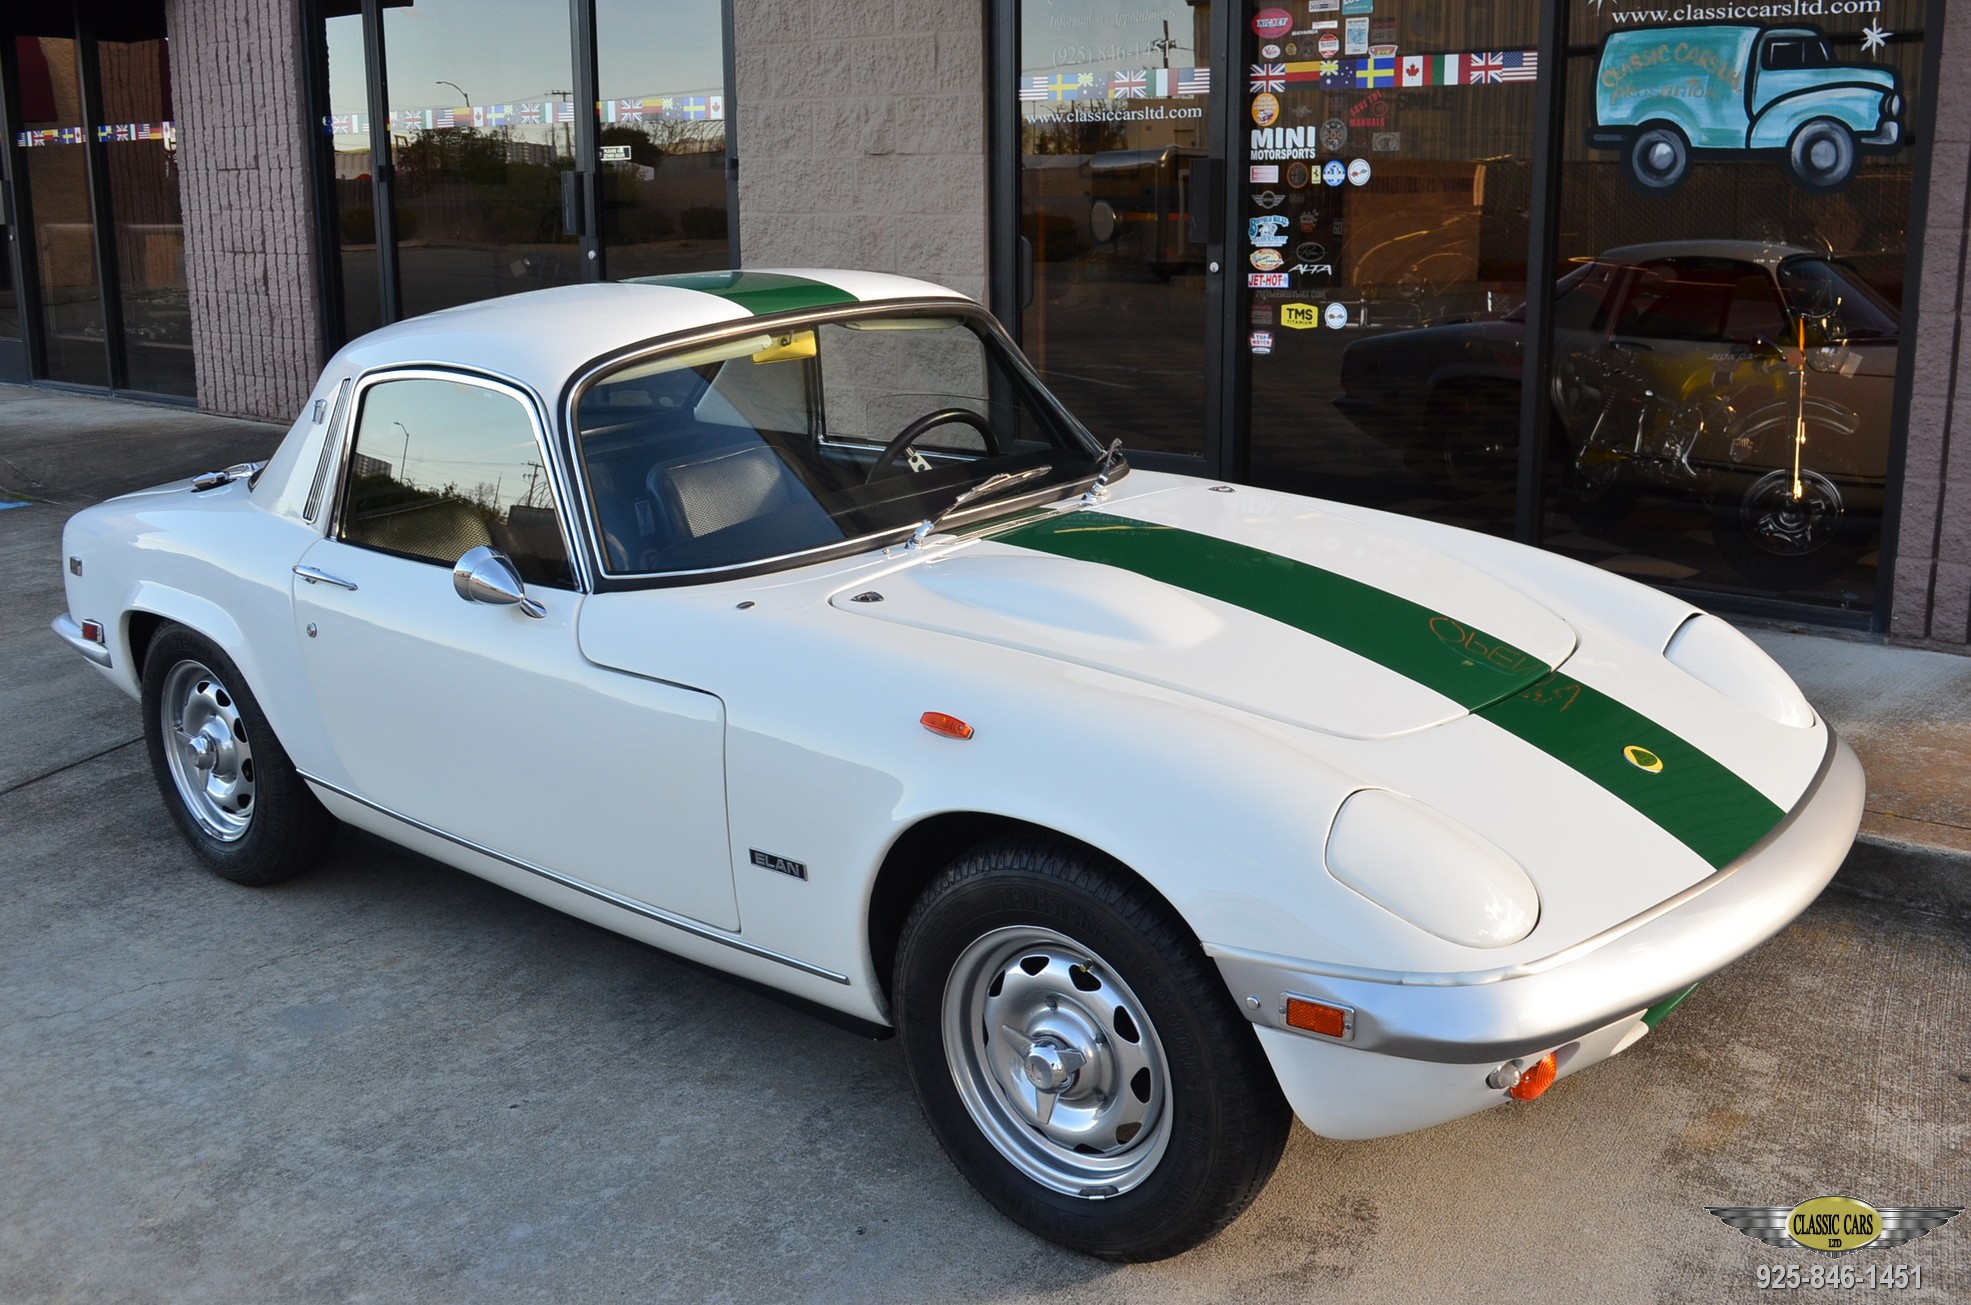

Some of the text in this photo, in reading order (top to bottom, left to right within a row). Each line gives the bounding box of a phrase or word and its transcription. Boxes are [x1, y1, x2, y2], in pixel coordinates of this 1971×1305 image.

[1050, 14, 1105, 31] Information
[1113, 10, 1176, 27] Appointments
[1612, 0, 1881, 24] www.classiccarsltd.com
[1052, 40, 1169, 69] (925) 846-1451
[1026, 105, 1203, 124] www.classiccarsltd.com
[1251, 126, 1316, 149] MINI
[1250, 148, 1316, 160] MOTORSPORTS
[1288, 264, 1332, 275] ALTA
[1248, 274, 1283, 286] JET-HOT
[1286, 307, 1313, 321] TMS
[753, 851, 800, 877] ELAN
